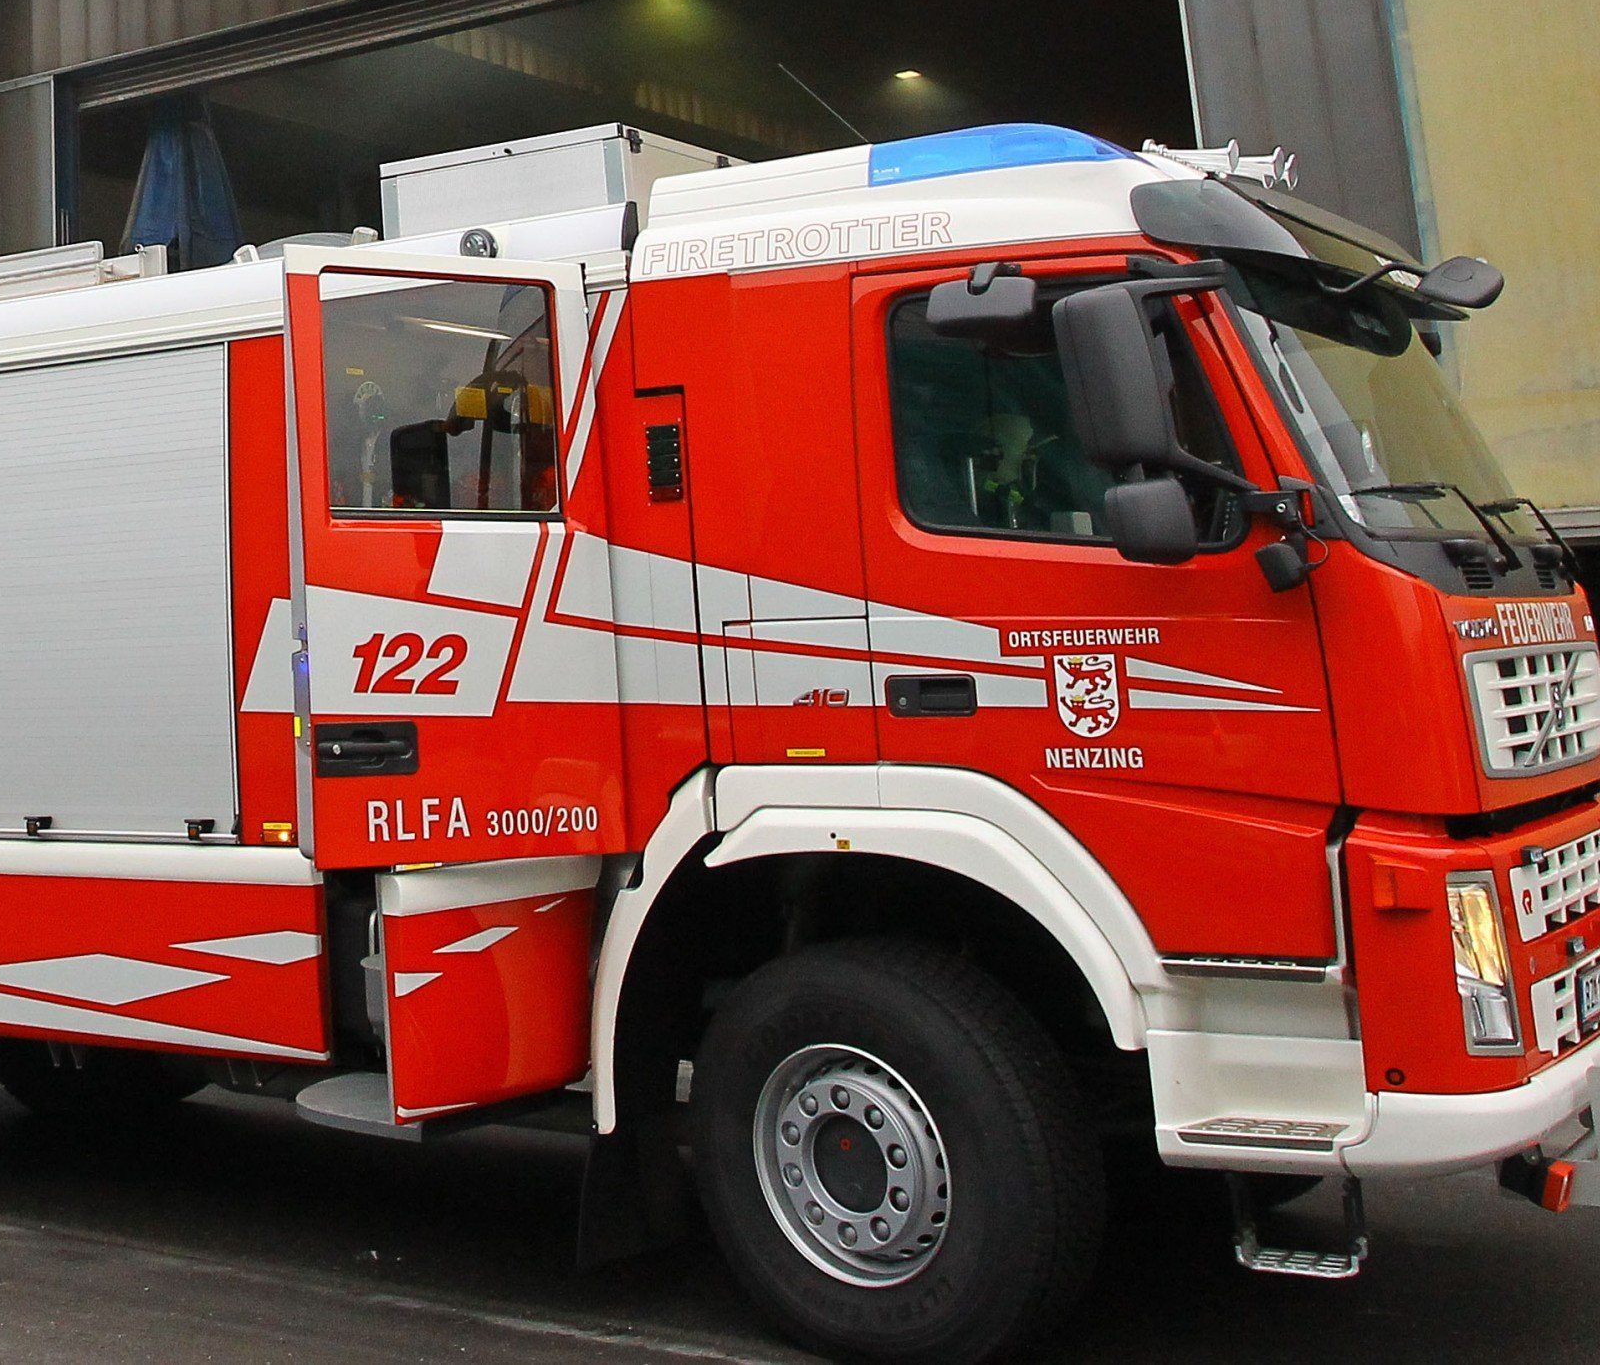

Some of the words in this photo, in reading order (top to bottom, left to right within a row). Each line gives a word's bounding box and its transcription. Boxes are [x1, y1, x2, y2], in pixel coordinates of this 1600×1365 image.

[642, 211, 953, 275] FIRETROTTER
[1008, 628, 1160, 648] ORTSFEUERWEHR
[1495, 602, 1577, 646] FEUERWEHR
[352, 632, 468, 695] 122
[793, 688, 850, 707] 410
[1045, 748, 1144, 769] NENZING
[367, 797, 471, 842] RLFA
[487, 805, 598, 836] 3000/200
